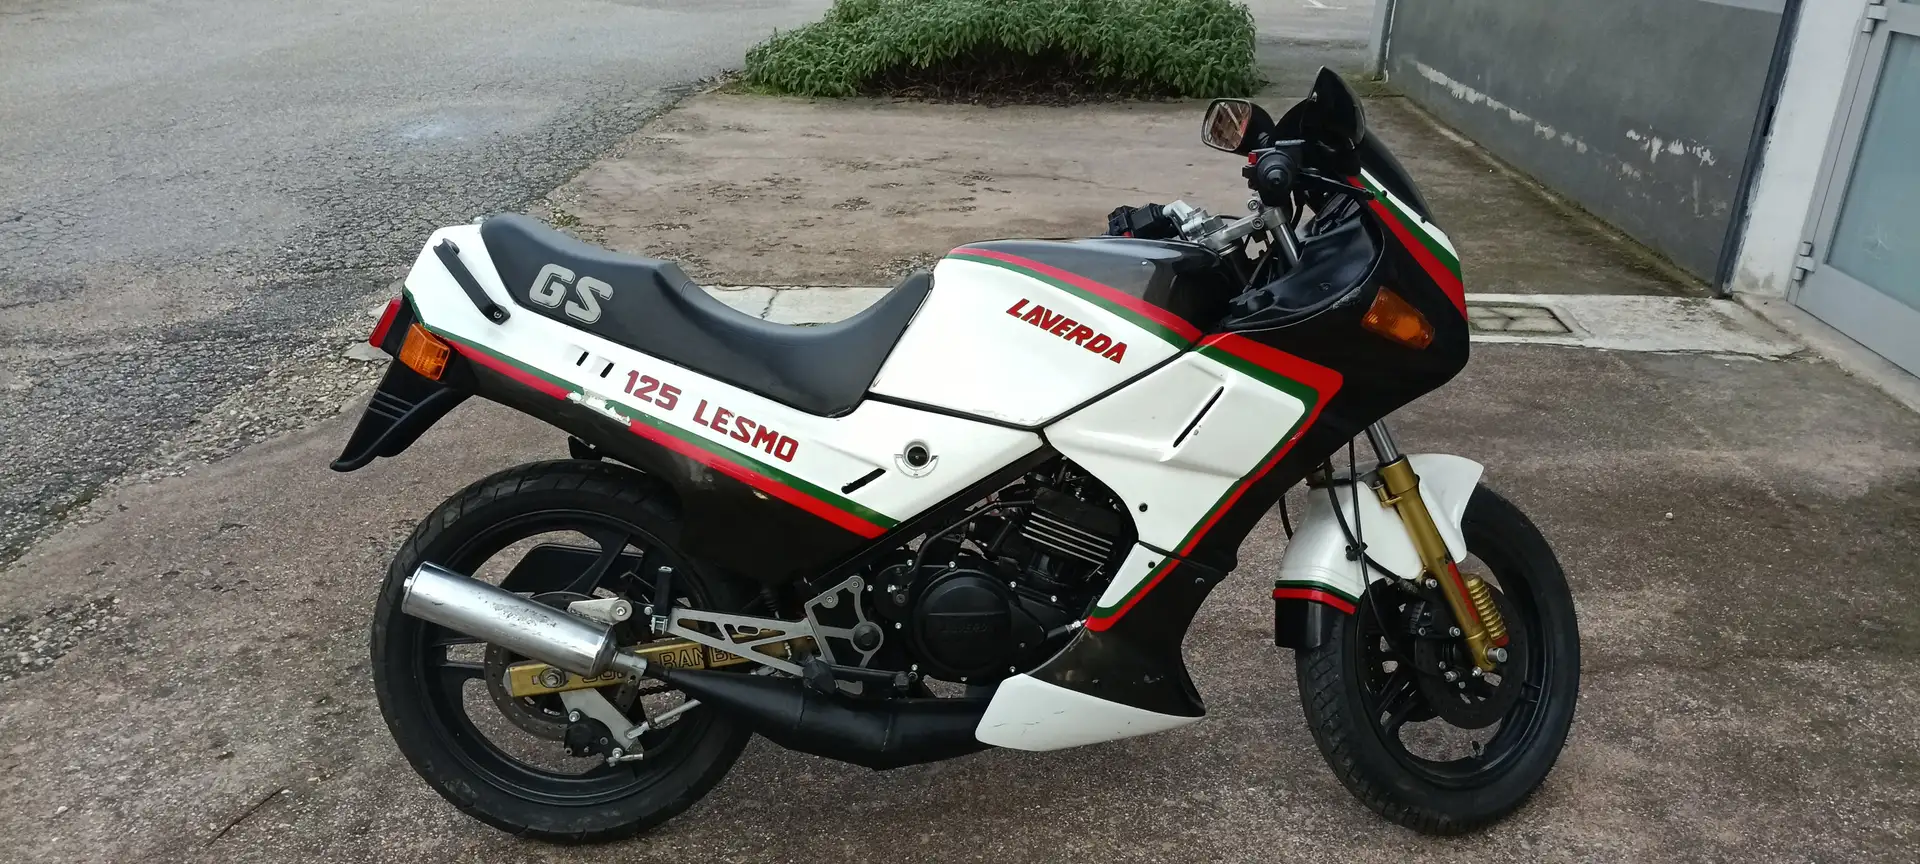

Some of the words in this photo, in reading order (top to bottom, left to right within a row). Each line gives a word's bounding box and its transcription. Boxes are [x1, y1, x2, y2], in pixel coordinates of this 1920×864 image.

[529, 263, 613, 324] GS
[1006, 298, 1127, 364] LAVERDA
[623, 369, 682, 411] 125
[692, 399, 799, 463] LESMO
